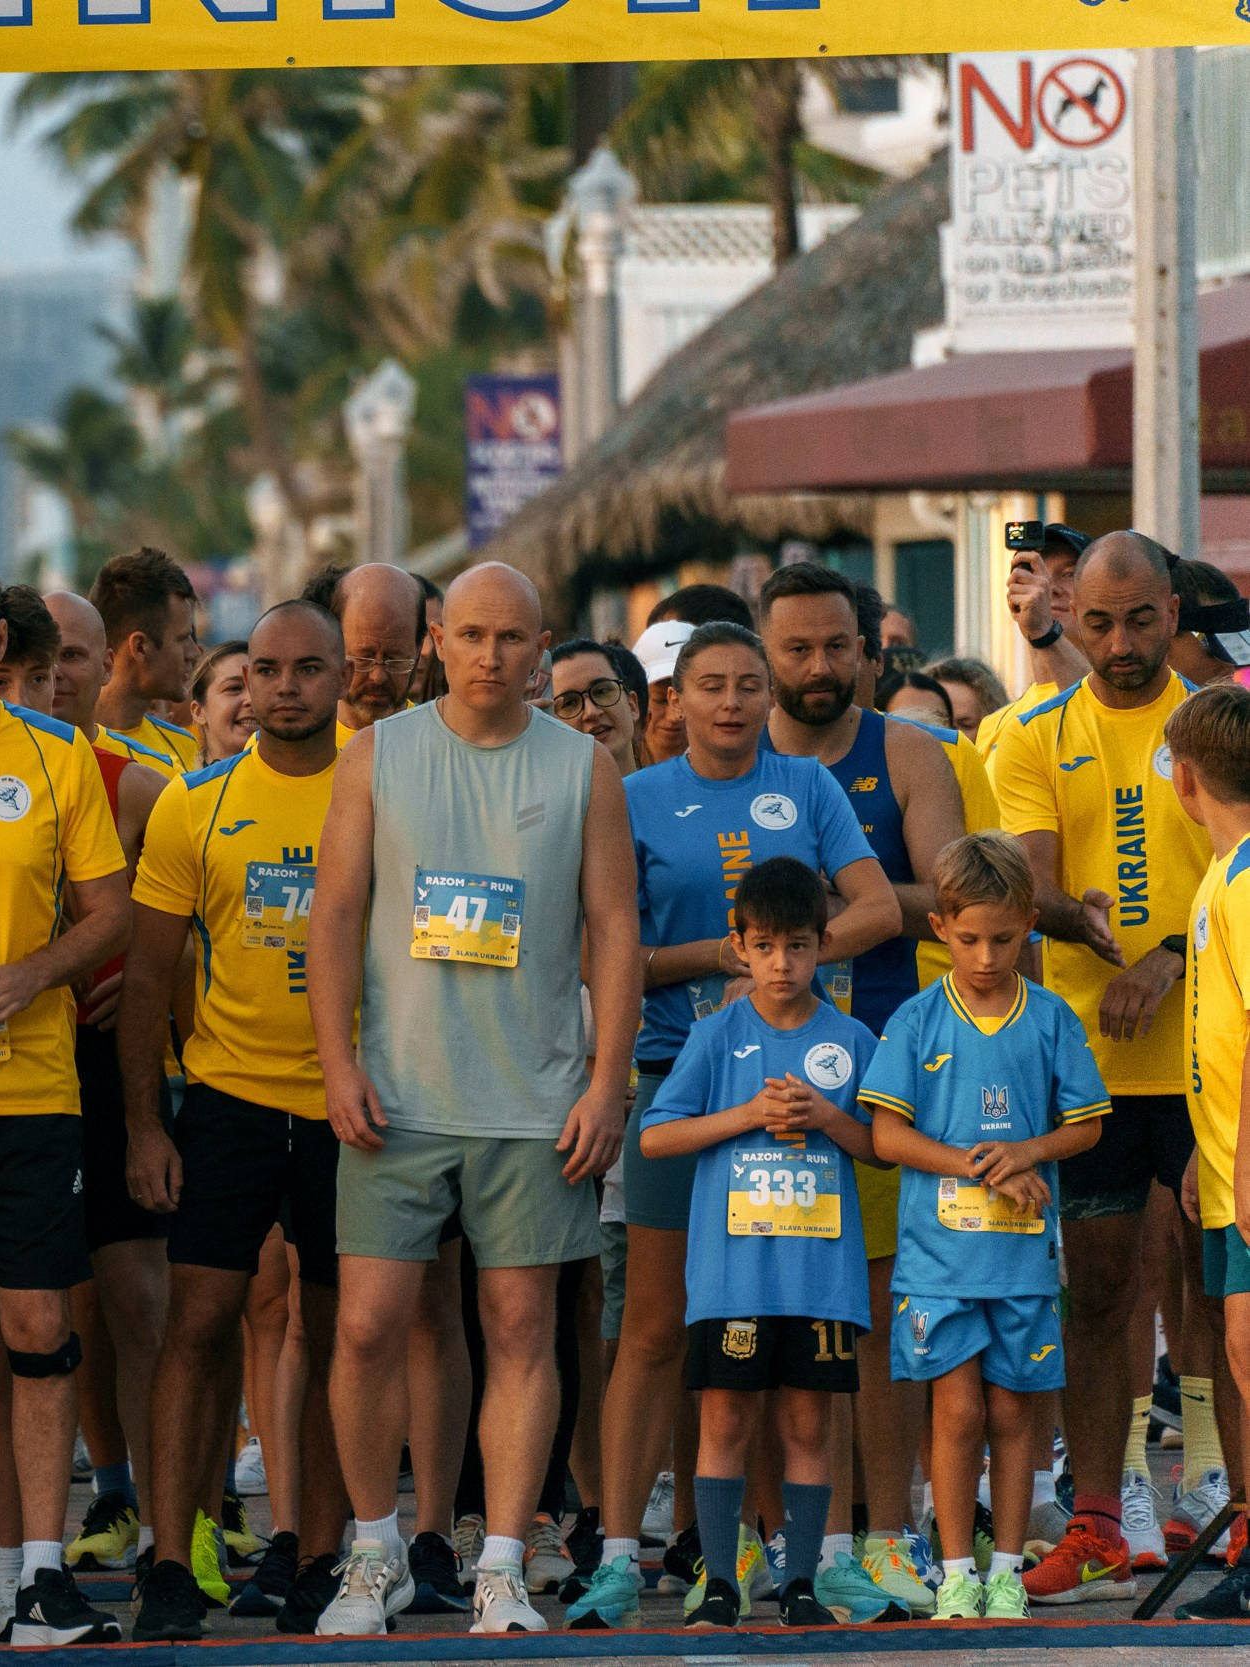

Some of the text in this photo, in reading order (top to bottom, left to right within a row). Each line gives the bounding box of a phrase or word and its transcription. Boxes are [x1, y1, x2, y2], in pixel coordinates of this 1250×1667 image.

[960, 156, 1130, 213] PETS
[258, 867, 298, 878] RAZOM
[1115, 784, 1150, 927] UKRAINE
[425, 876, 514, 893] RAZOM RUN
[282, 886, 315, 921] 74
[446, 895, 487, 933] 47
[455, 949, 479, 957] SLAVA
[980, 1122, 1012, 1131] UKRAINE
[742, 1153, 828, 1164] RAZOM RUN
[748, 1169, 817, 1208] 333
[811, 1319, 856, 1362] 10
